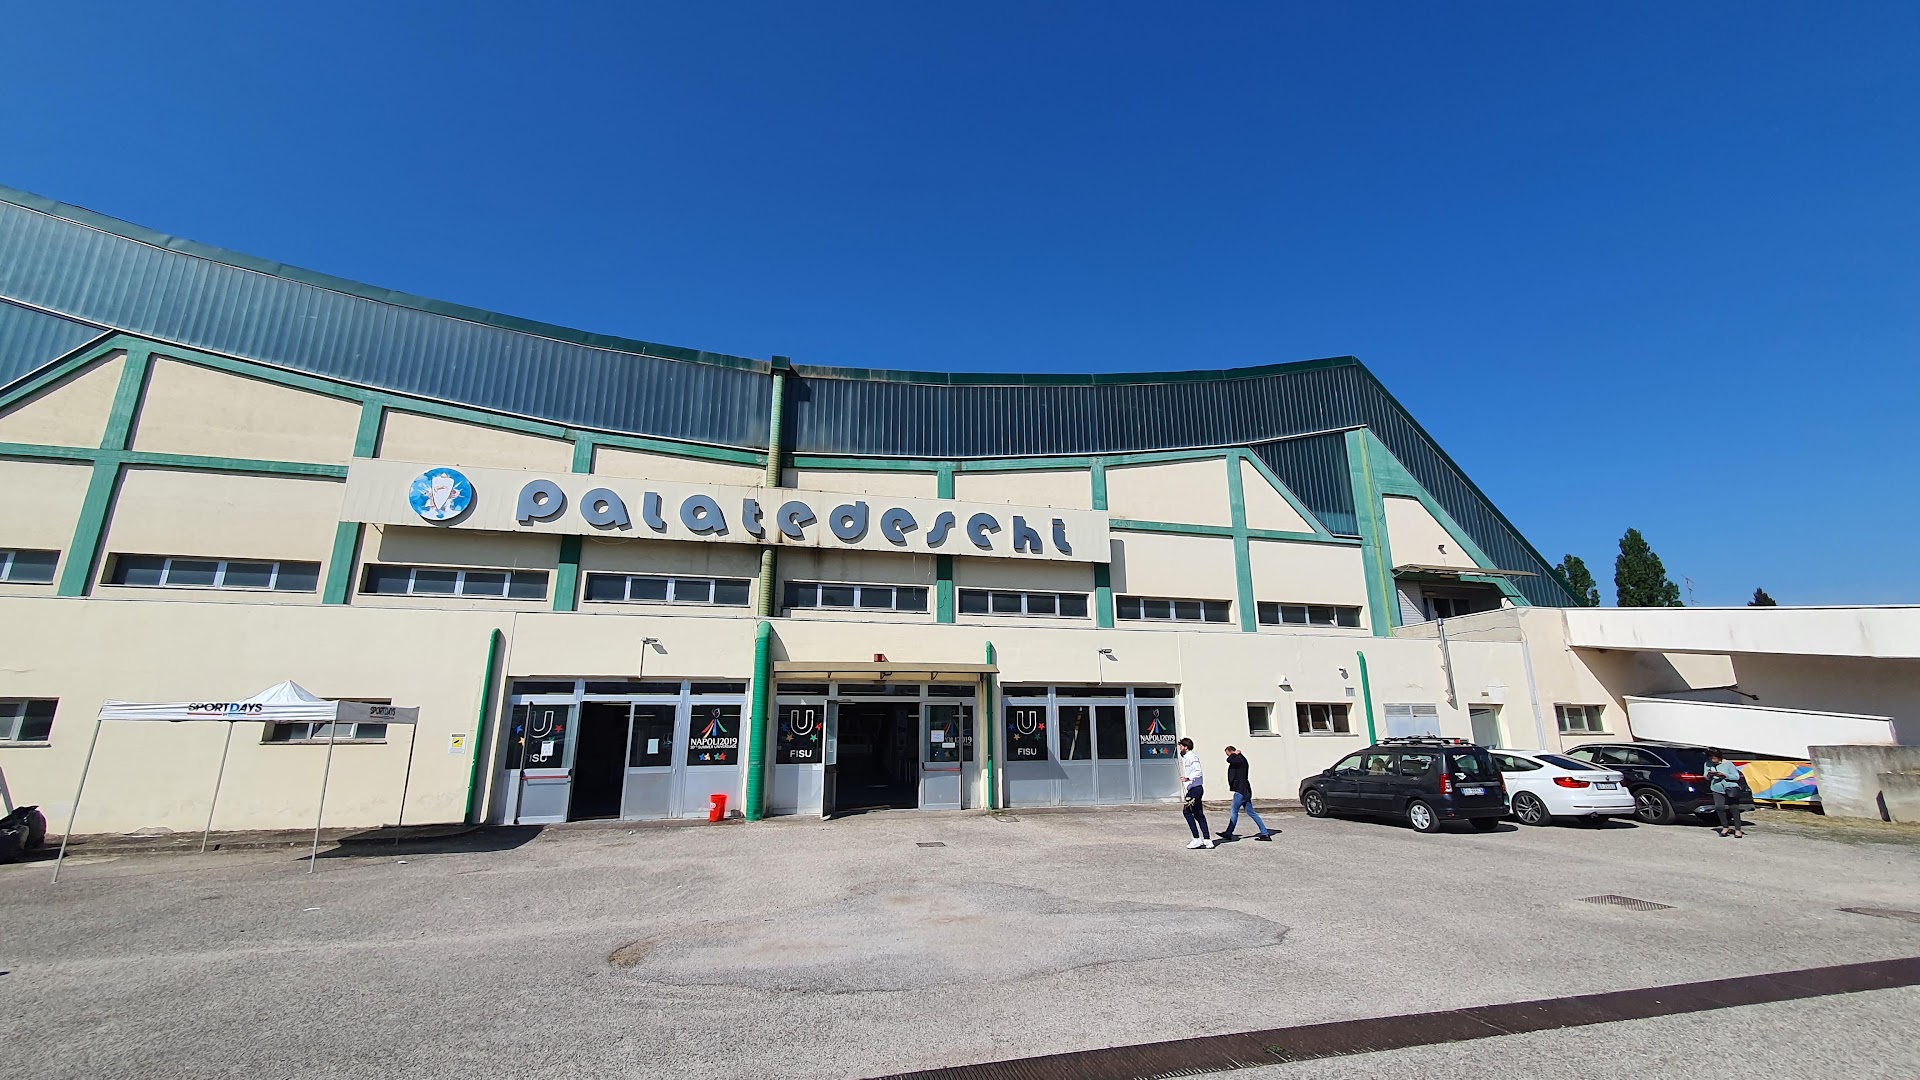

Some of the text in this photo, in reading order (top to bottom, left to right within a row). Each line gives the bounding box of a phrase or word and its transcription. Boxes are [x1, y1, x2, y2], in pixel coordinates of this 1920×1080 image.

[188, 702, 263, 713] SPORTDAYS
[790, 749, 813, 758] FISU
[1017, 747, 1037, 756] FISU
